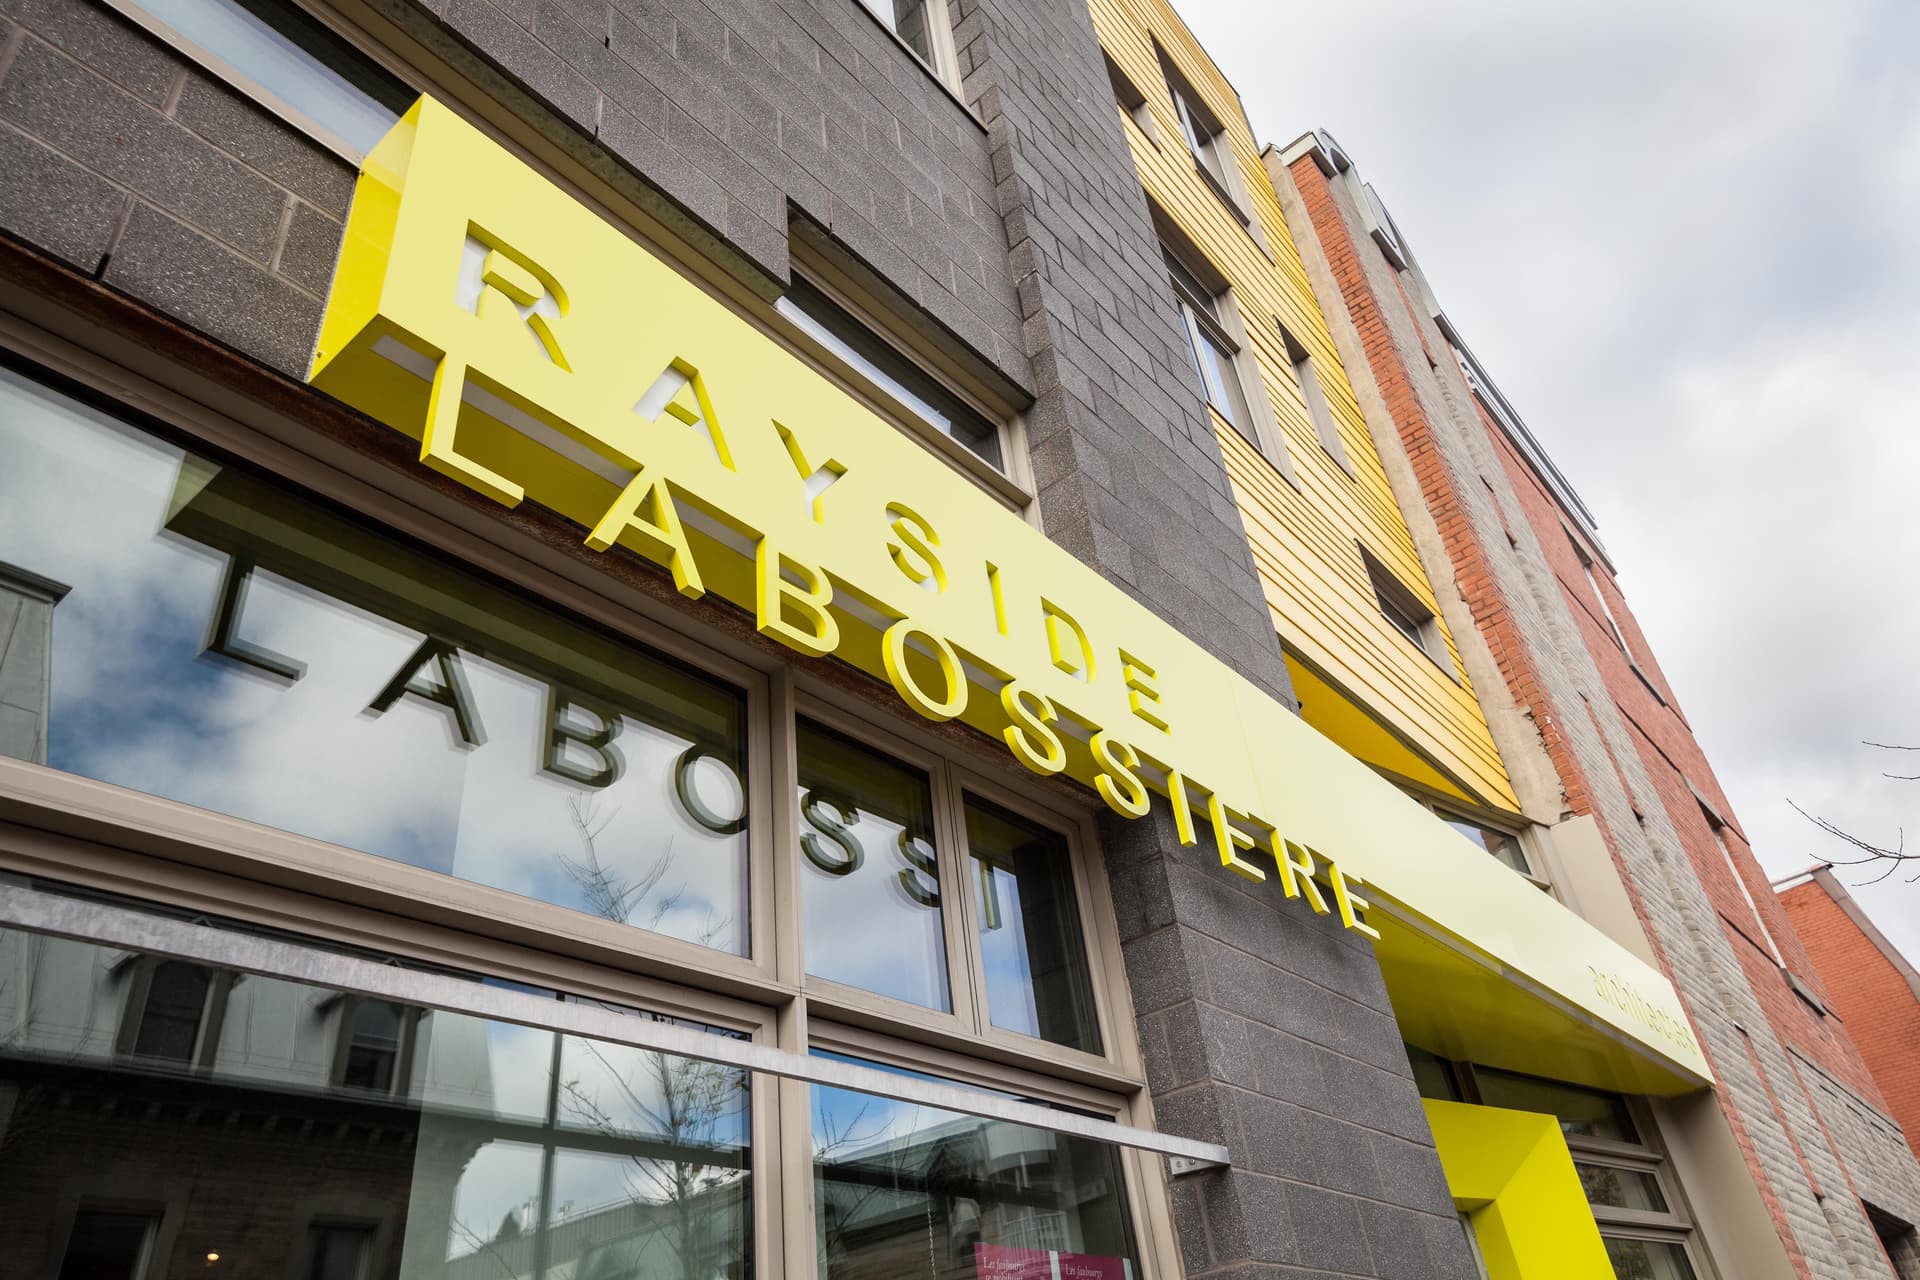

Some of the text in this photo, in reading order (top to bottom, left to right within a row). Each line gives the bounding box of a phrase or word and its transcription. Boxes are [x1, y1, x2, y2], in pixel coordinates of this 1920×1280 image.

[455, 219, 1171, 736] RAYSIDE
[420, 353, 1381, 941] LABOSSIERE
[1586, 963, 1699, 1057] architectes
[983, 1256, 1025, 1273] Les faubourgs
[1065, 1263, 1103, 1280] Les faubourgs
